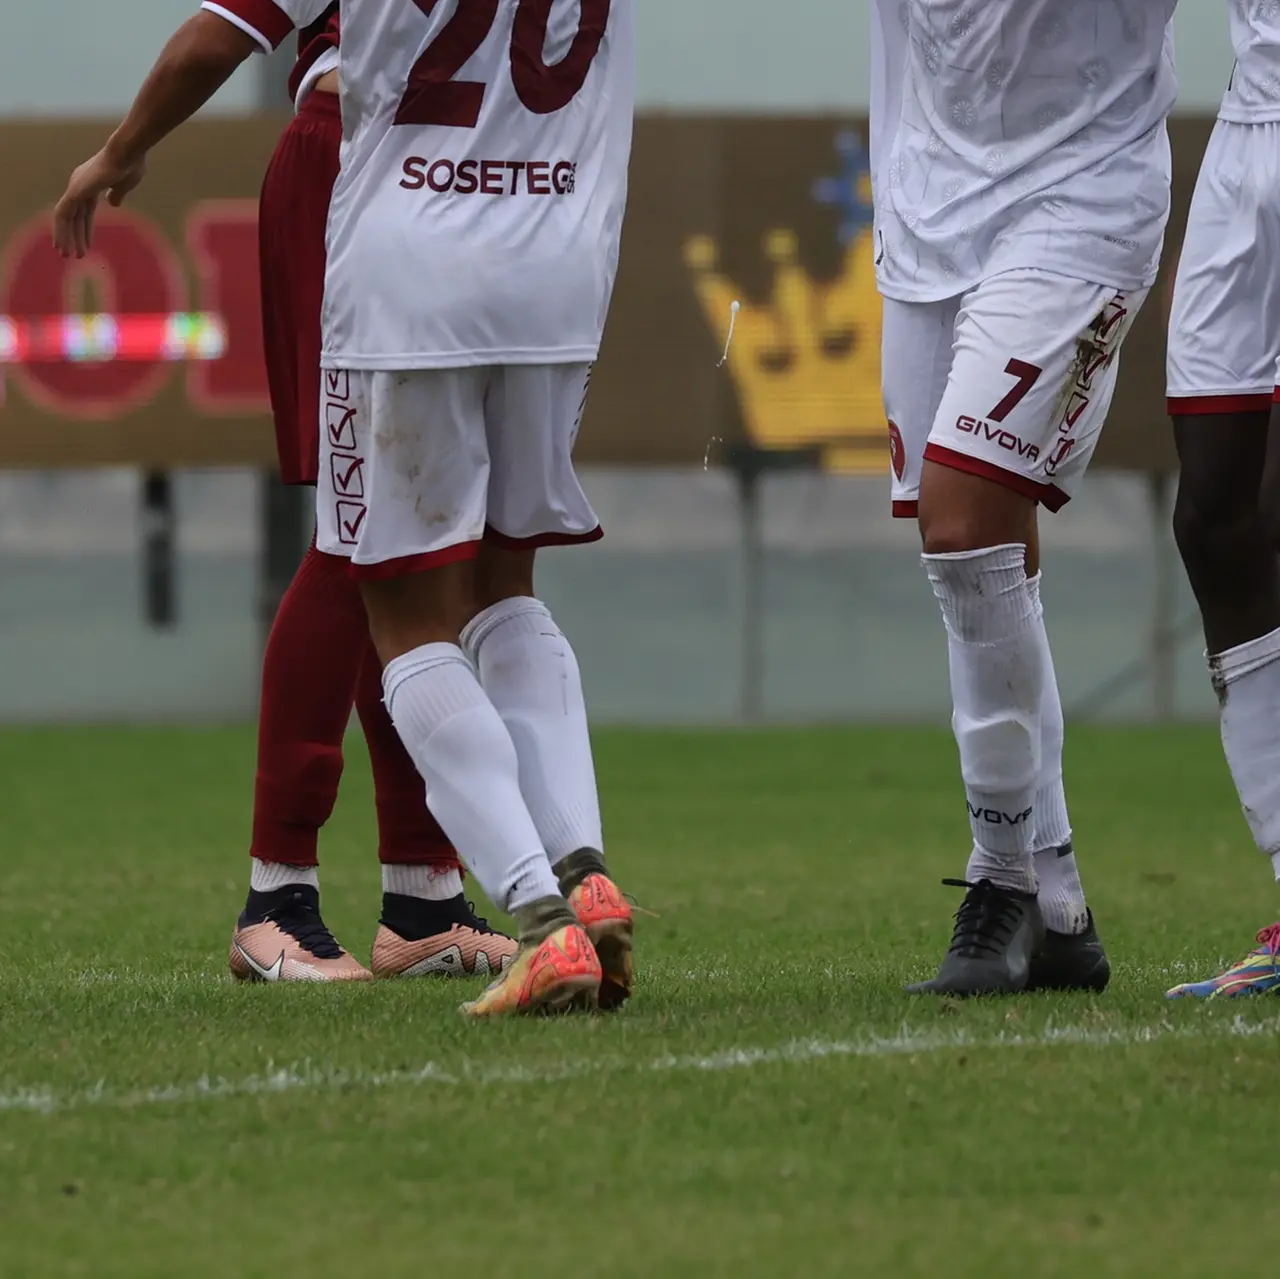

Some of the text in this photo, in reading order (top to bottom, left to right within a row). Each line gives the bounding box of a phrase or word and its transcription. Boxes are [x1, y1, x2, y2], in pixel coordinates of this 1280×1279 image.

[399, 156, 574, 195] SOSETEG
[985, 356, 1043, 424] 7
[955, 414, 1041, 463] GIVOVA
